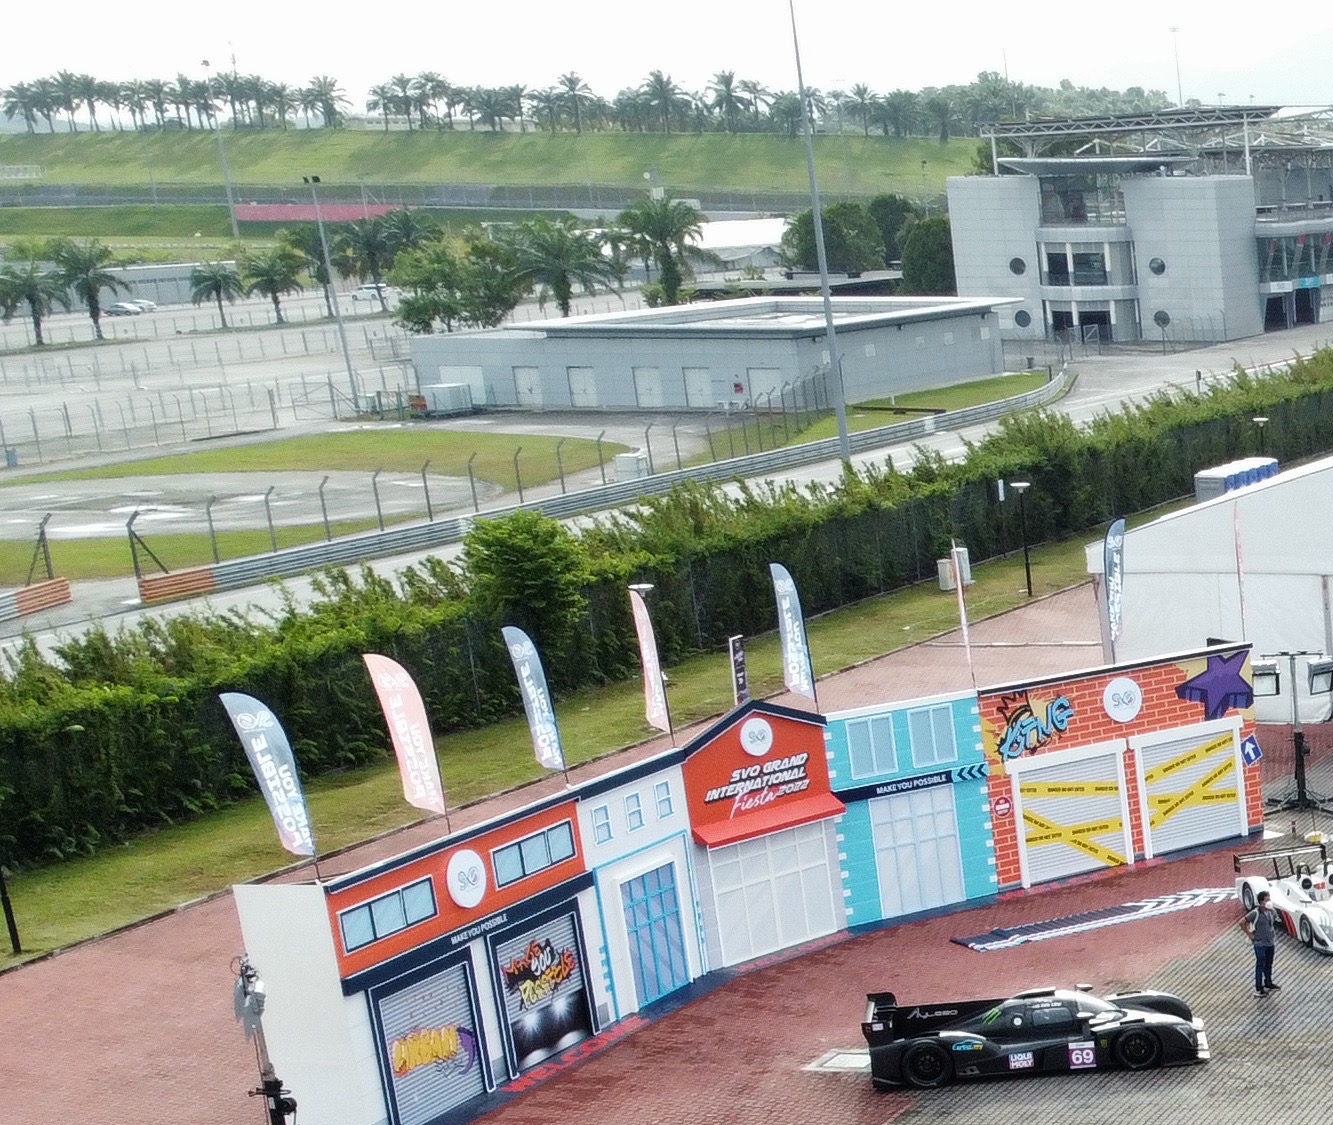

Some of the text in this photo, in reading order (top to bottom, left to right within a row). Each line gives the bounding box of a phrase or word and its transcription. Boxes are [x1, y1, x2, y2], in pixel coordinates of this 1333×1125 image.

[730, 753, 809, 783] SVO GRAND
[704, 766, 807, 804] INTERNATIONAL
[730, 779, 810, 820] Fiesta 2022
[876, 774, 947, 795] MAKE YOU POSSIBLE
[451, 914, 508, 945] MAKE YOU POSSIBLE
[500, 1015, 650, 1093] WELCOME
[1010, 1060, 1034, 1069] MOLY
[1071, 1050, 1094, 1064] 69
